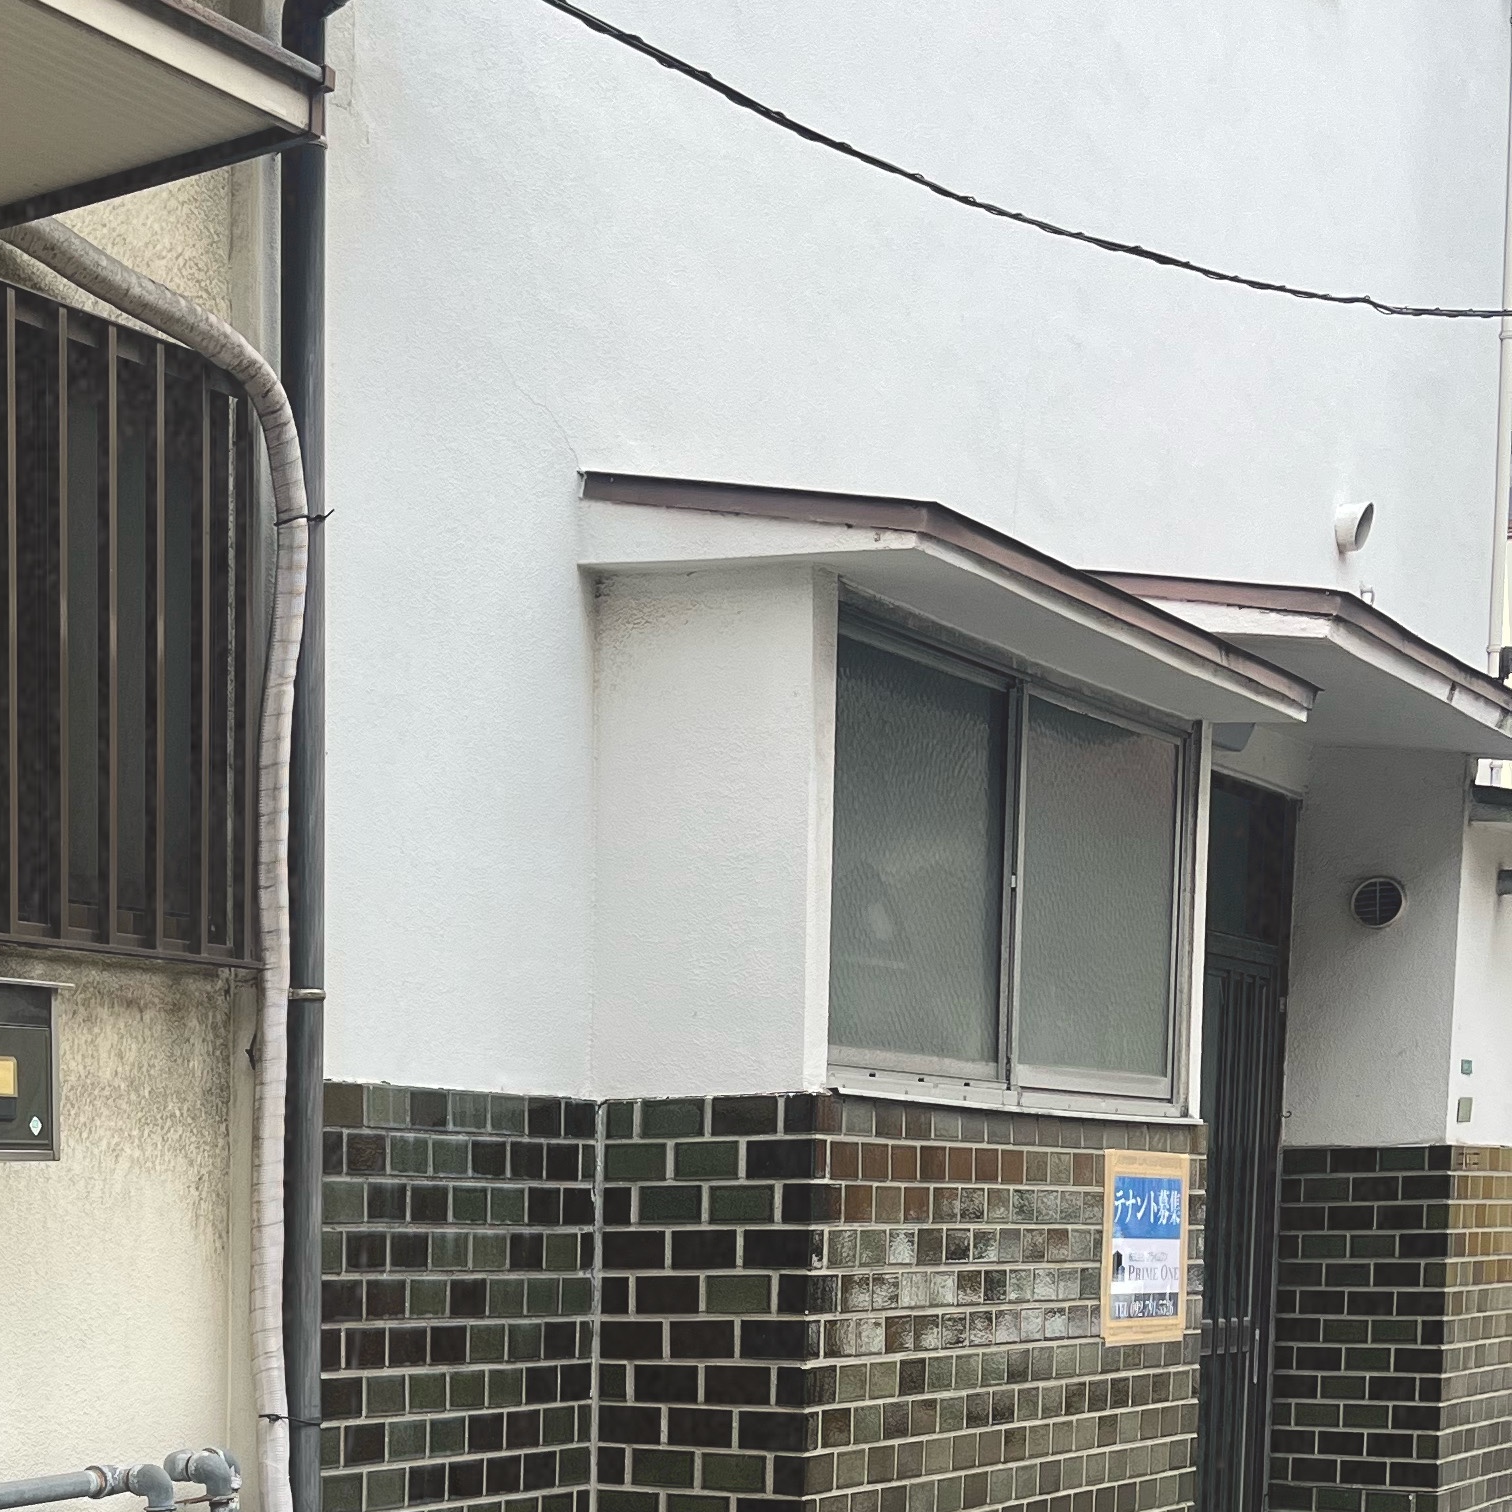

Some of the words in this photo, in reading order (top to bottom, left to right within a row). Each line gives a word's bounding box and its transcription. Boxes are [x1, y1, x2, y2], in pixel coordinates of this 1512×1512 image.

[1114, 1189, 1181, 1226] テナント募集
[1128, 1264, 1158, 1281] PRIME
[1161, 1264, 1179, 1281] ONE
